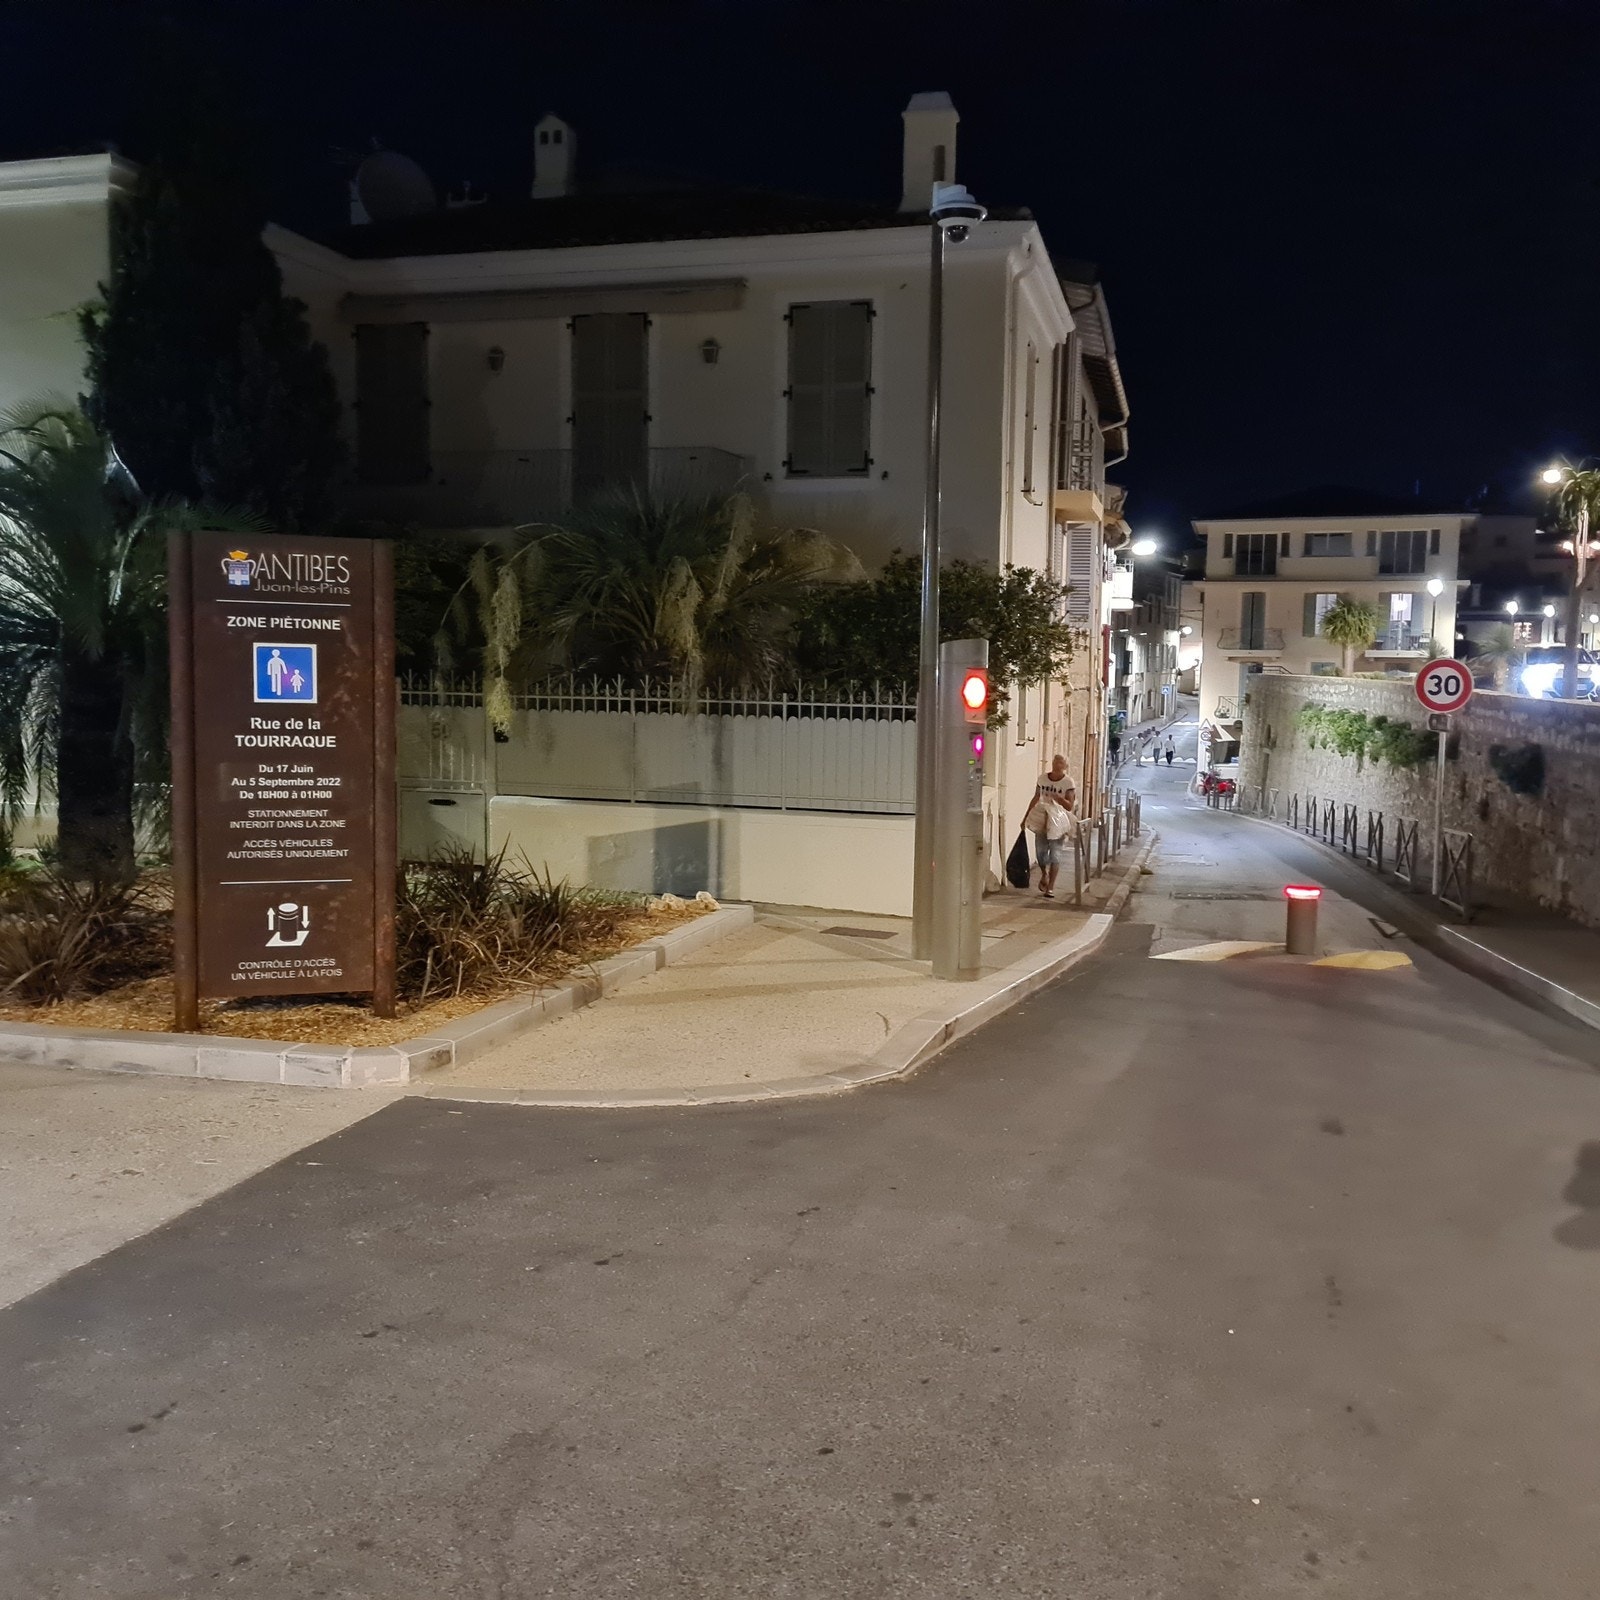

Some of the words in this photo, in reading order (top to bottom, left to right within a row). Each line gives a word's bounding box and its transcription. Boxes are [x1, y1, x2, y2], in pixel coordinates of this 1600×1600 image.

[254, 553, 350, 583] ANTIBES
[254, 578, 351, 595] Juan-les-Pins
[227, 616, 267, 628] ZONE
[270, 616, 341, 630] PIÉTONNE
[1428, 675, 1460, 696] 30
[250, 717, 281, 730] Rue
[285, 718, 304, 730] de
[308, 718, 321, 730] la
[234, 735, 337, 748] TOURRAQUE
[258, 764, 273, 773] Du
[276, 764, 288, 773] 17
[291, 764, 314, 773] Juin
[231, 777, 246, 786] Au
[249, 777, 256, 786] 5
[258, 777, 314, 788] Septembre
[316, 777, 341, 786] 2022
[240, 790, 254, 799] De
[257, 790, 289, 799] 18H00
[291, 790, 298, 799] à
[300, 790, 333, 799] 01H00
[248, 809, 329, 818] STATIONNEMENT
[230, 820, 274, 829] INTERDIT
[276, 820, 304, 829] DANS
[305, 820, 318, 828] LA
[319, 819, 346, 828] ZONE
[285, 849, 349, 858] UNIQUEMENT
[238, 959, 292, 970] CONTRÔLE
[231, 972, 246, 981] UN
[306, 969, 319, 978] LA
[320, 968, 343, 977] FOIS
